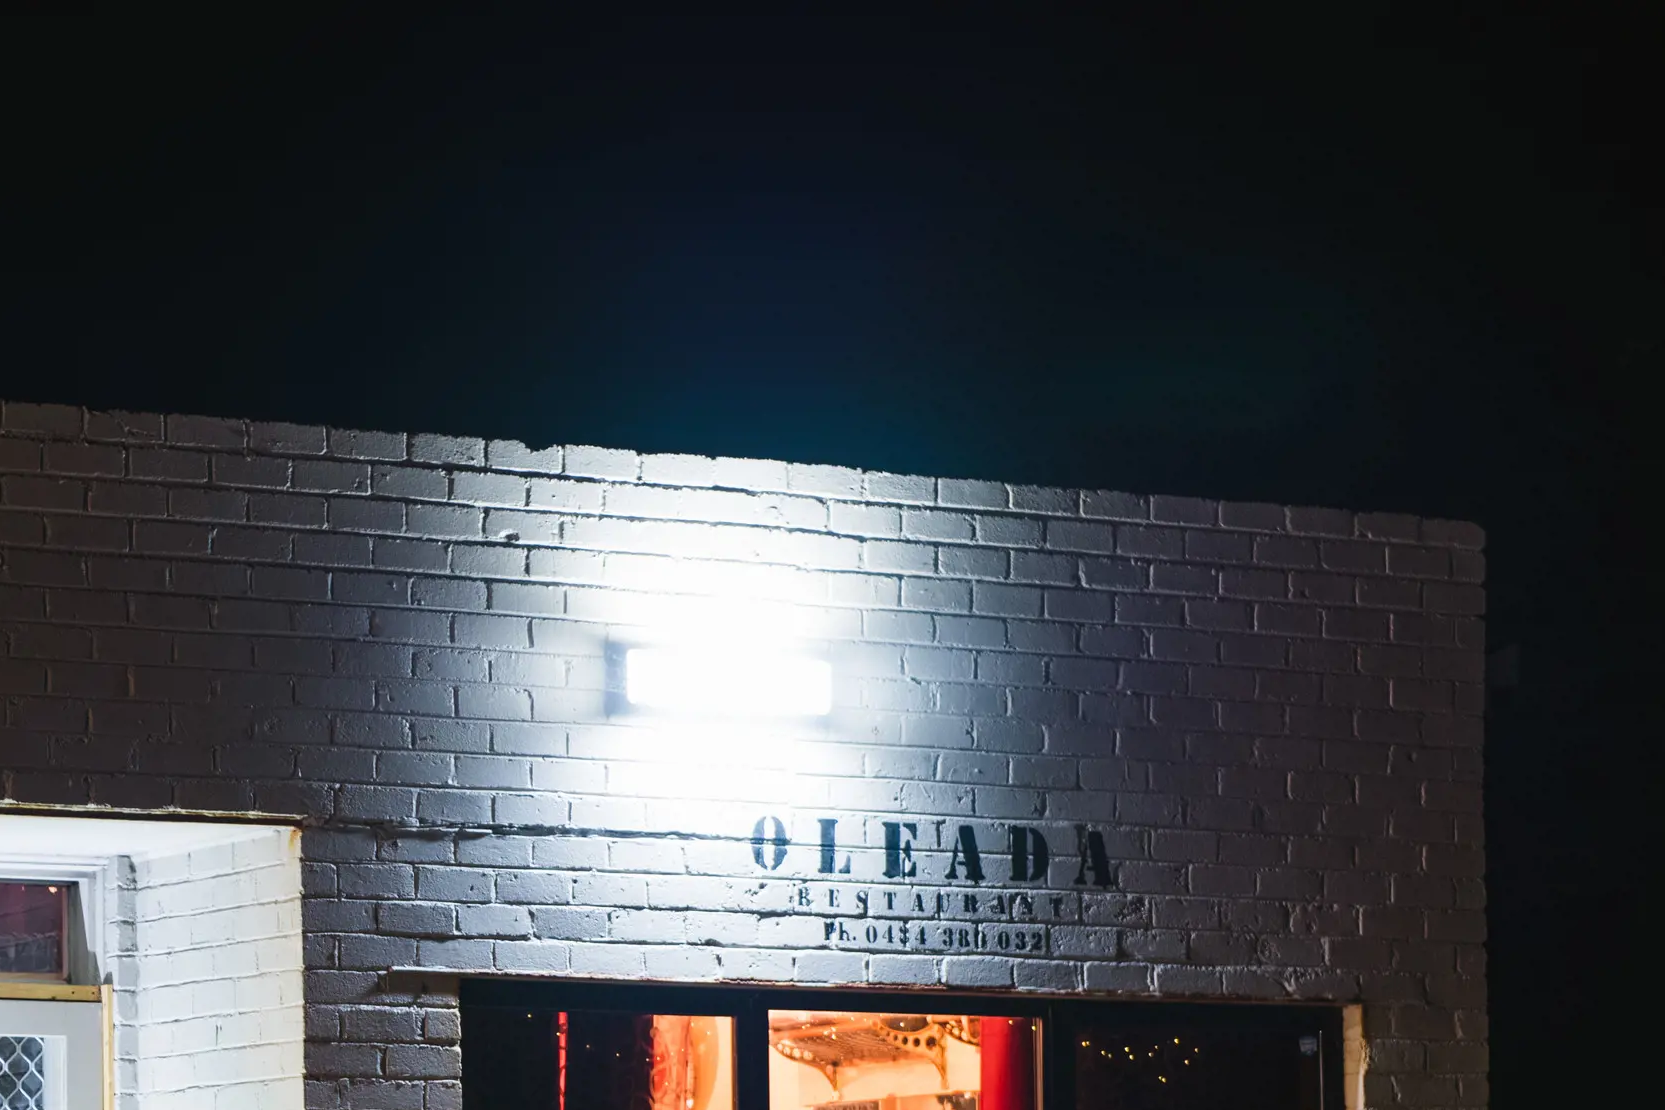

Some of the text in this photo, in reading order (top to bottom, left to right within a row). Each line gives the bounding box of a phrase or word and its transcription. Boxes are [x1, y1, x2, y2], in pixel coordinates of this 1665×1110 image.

[750, 814, 1114, 887] OLEADA
[797, 886, 1063, 918] RESTAURANT
[823, 921, 857, 942] Ph.
[998, 929, 1044, 952] 032
